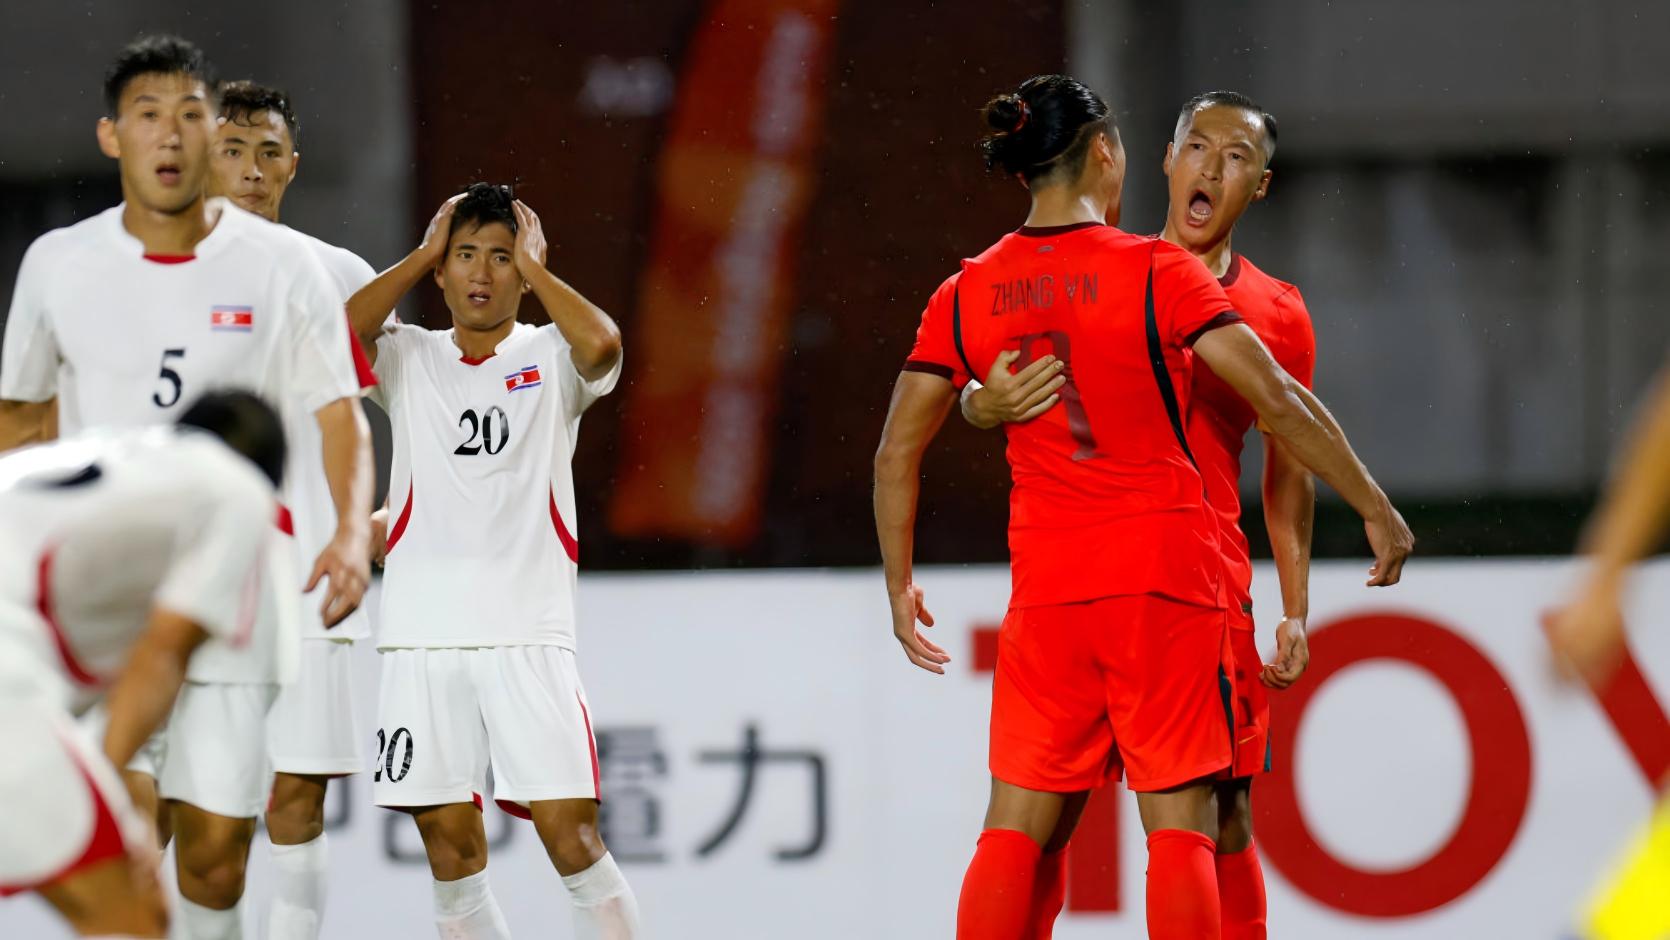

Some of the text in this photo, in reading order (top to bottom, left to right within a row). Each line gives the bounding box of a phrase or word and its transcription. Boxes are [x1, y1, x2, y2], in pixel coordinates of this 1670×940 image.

[991, 275, 1054, 316] ZHANG
[153, 348, 185, 407] 5
[454, 406, 509, 455] 20
